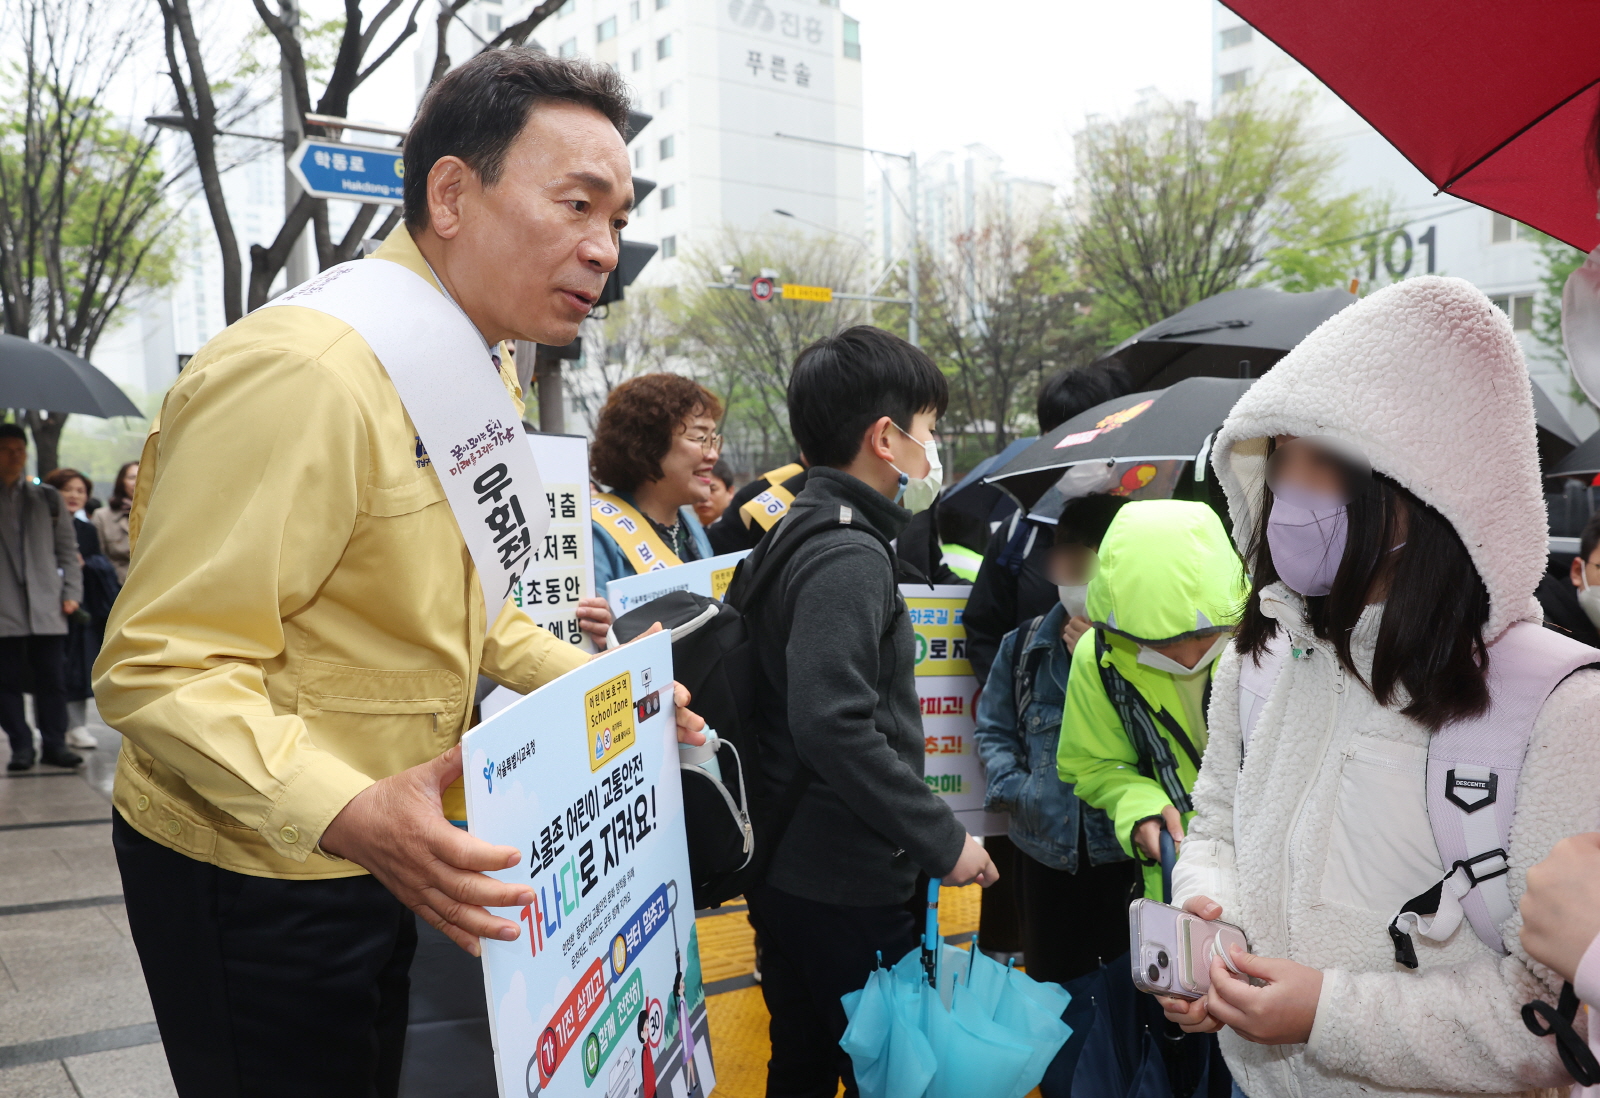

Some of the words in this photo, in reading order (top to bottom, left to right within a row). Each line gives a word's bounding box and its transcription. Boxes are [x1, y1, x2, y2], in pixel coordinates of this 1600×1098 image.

[746, 49, 811, 88] 푸른솔
[314, 151, 366, 172] 학동로
[1360, 226, 1436, 280] 101
[491, 426, 515, 446] 강남
[473, 463, 532, 571] 우회전
[589, 678, 628, 709] 어린이보호구역
[591, 703, 613, 728] School
[613, 698, 629, 715] Zone
[496, 738, 536, 780] 서울특별시교육청
[1455, 780, 1486, 788] DESCENTE
[530, 814, 566, 880] 스쿨존
[566, 784, 601, 842] 어린이
[601, 751, 645, 810] 교통안전
[520, 838, 599, 958] 가나다로
[599, 784, 658, 877] 지켜요!
[641, 894, 666, 935] 멈추고
[575, 968, 604, 1022] 살피고
[616, 977, 642, 1027] 천천히
[649, 1010, 661, 1036] 30
